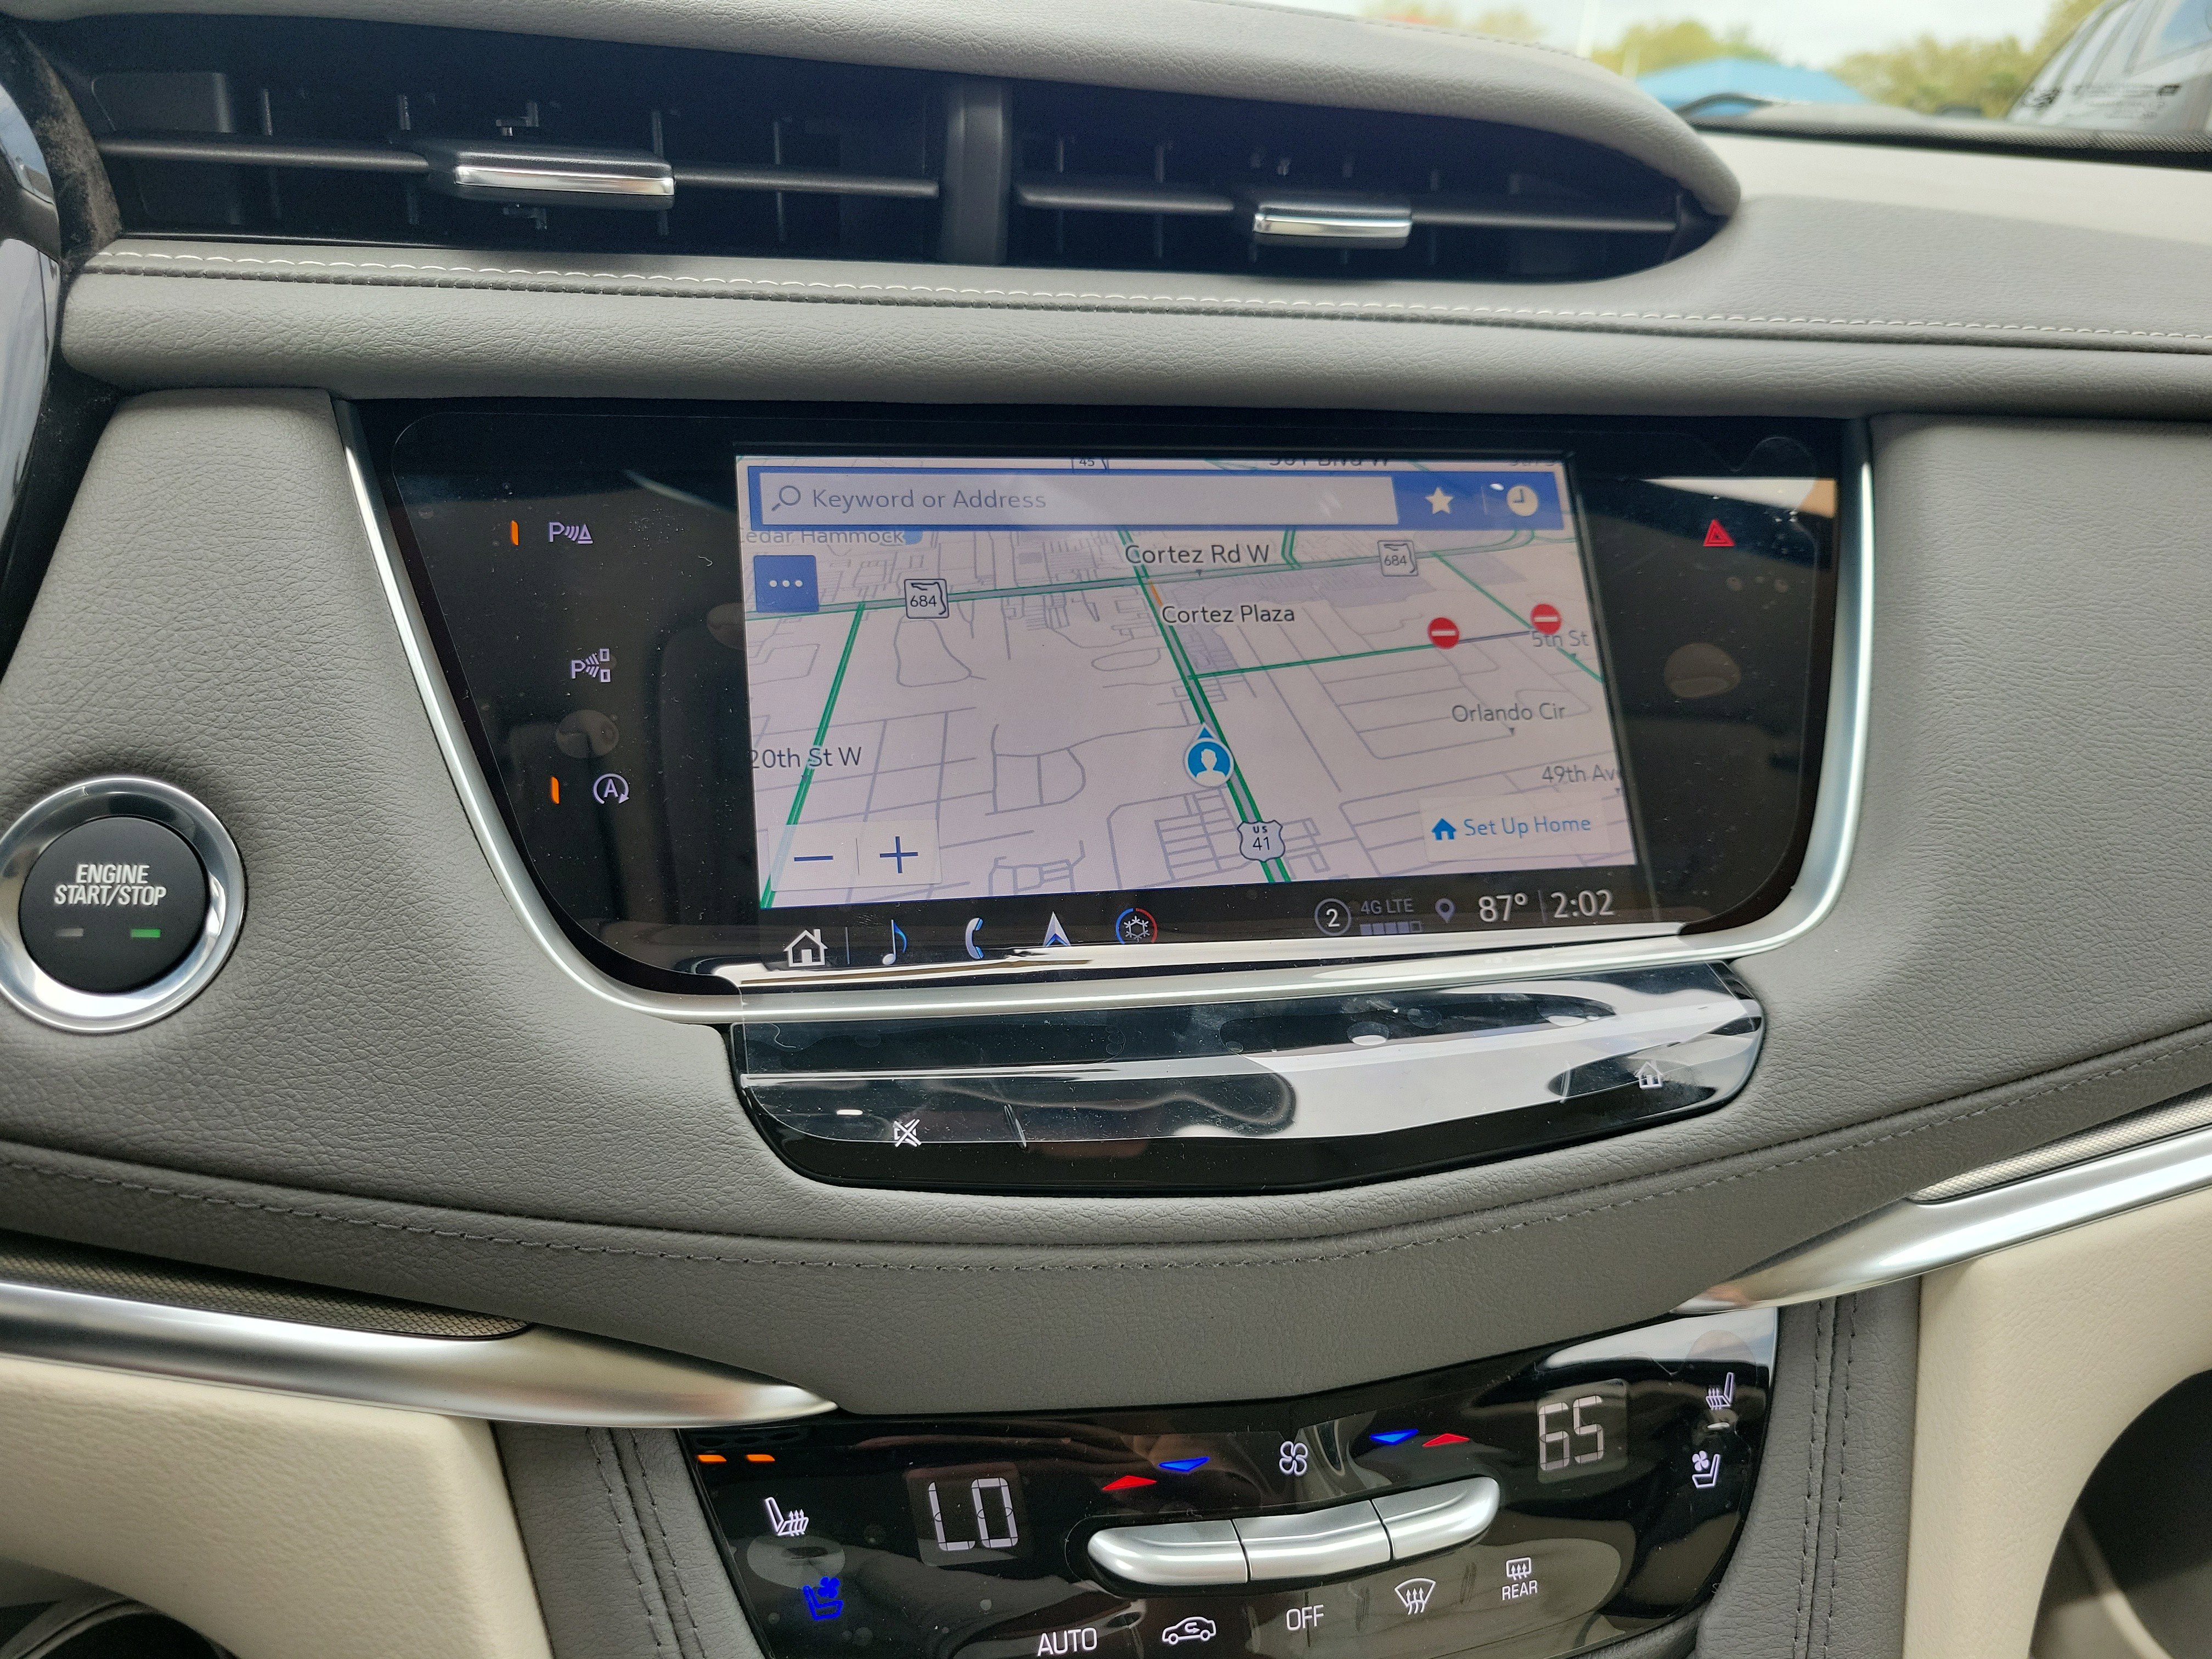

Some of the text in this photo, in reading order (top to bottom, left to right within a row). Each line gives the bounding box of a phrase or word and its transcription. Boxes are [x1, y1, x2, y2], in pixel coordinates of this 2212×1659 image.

[812, 489, 1046, 513] Keyword or Address
[802, 530, 904, 544] Hammock
[1125, 544, 1270, 565] Cortez Rd W
[1384, 554, 1408, 567] 684
[910, 595, 938, 607] 684
[1162, 603, 1295, 624] Cortez Plaza
[1568, 630, 1589, 646] St
[1451, 703, 1566, 722] Orlando Cir
[751, 747, 862, 769] 20th St W
[1542, 764, 1587, 783] 49th
[1252, 825, 1268, 834] US
[1464, 816, 1591, 837] Set Up Home
[1252, 836, 1271, 851] 41
[76, 864, 150, 884] ENGINE
[54, 884, 167, 906] START/STOP
[1553, 890, 1615, 919] 2:02
[1361, 898, 1414, 914] 4G LTE
[1327, 910, 1340, 928] 2
[1538, 1395, 1604, 1471] 65
[1502, 1580, 1538, 1601] REAR
[1286, 1605, 1324, 1632] OFF
[1037, 1627, 1098, 1657] AUTO
